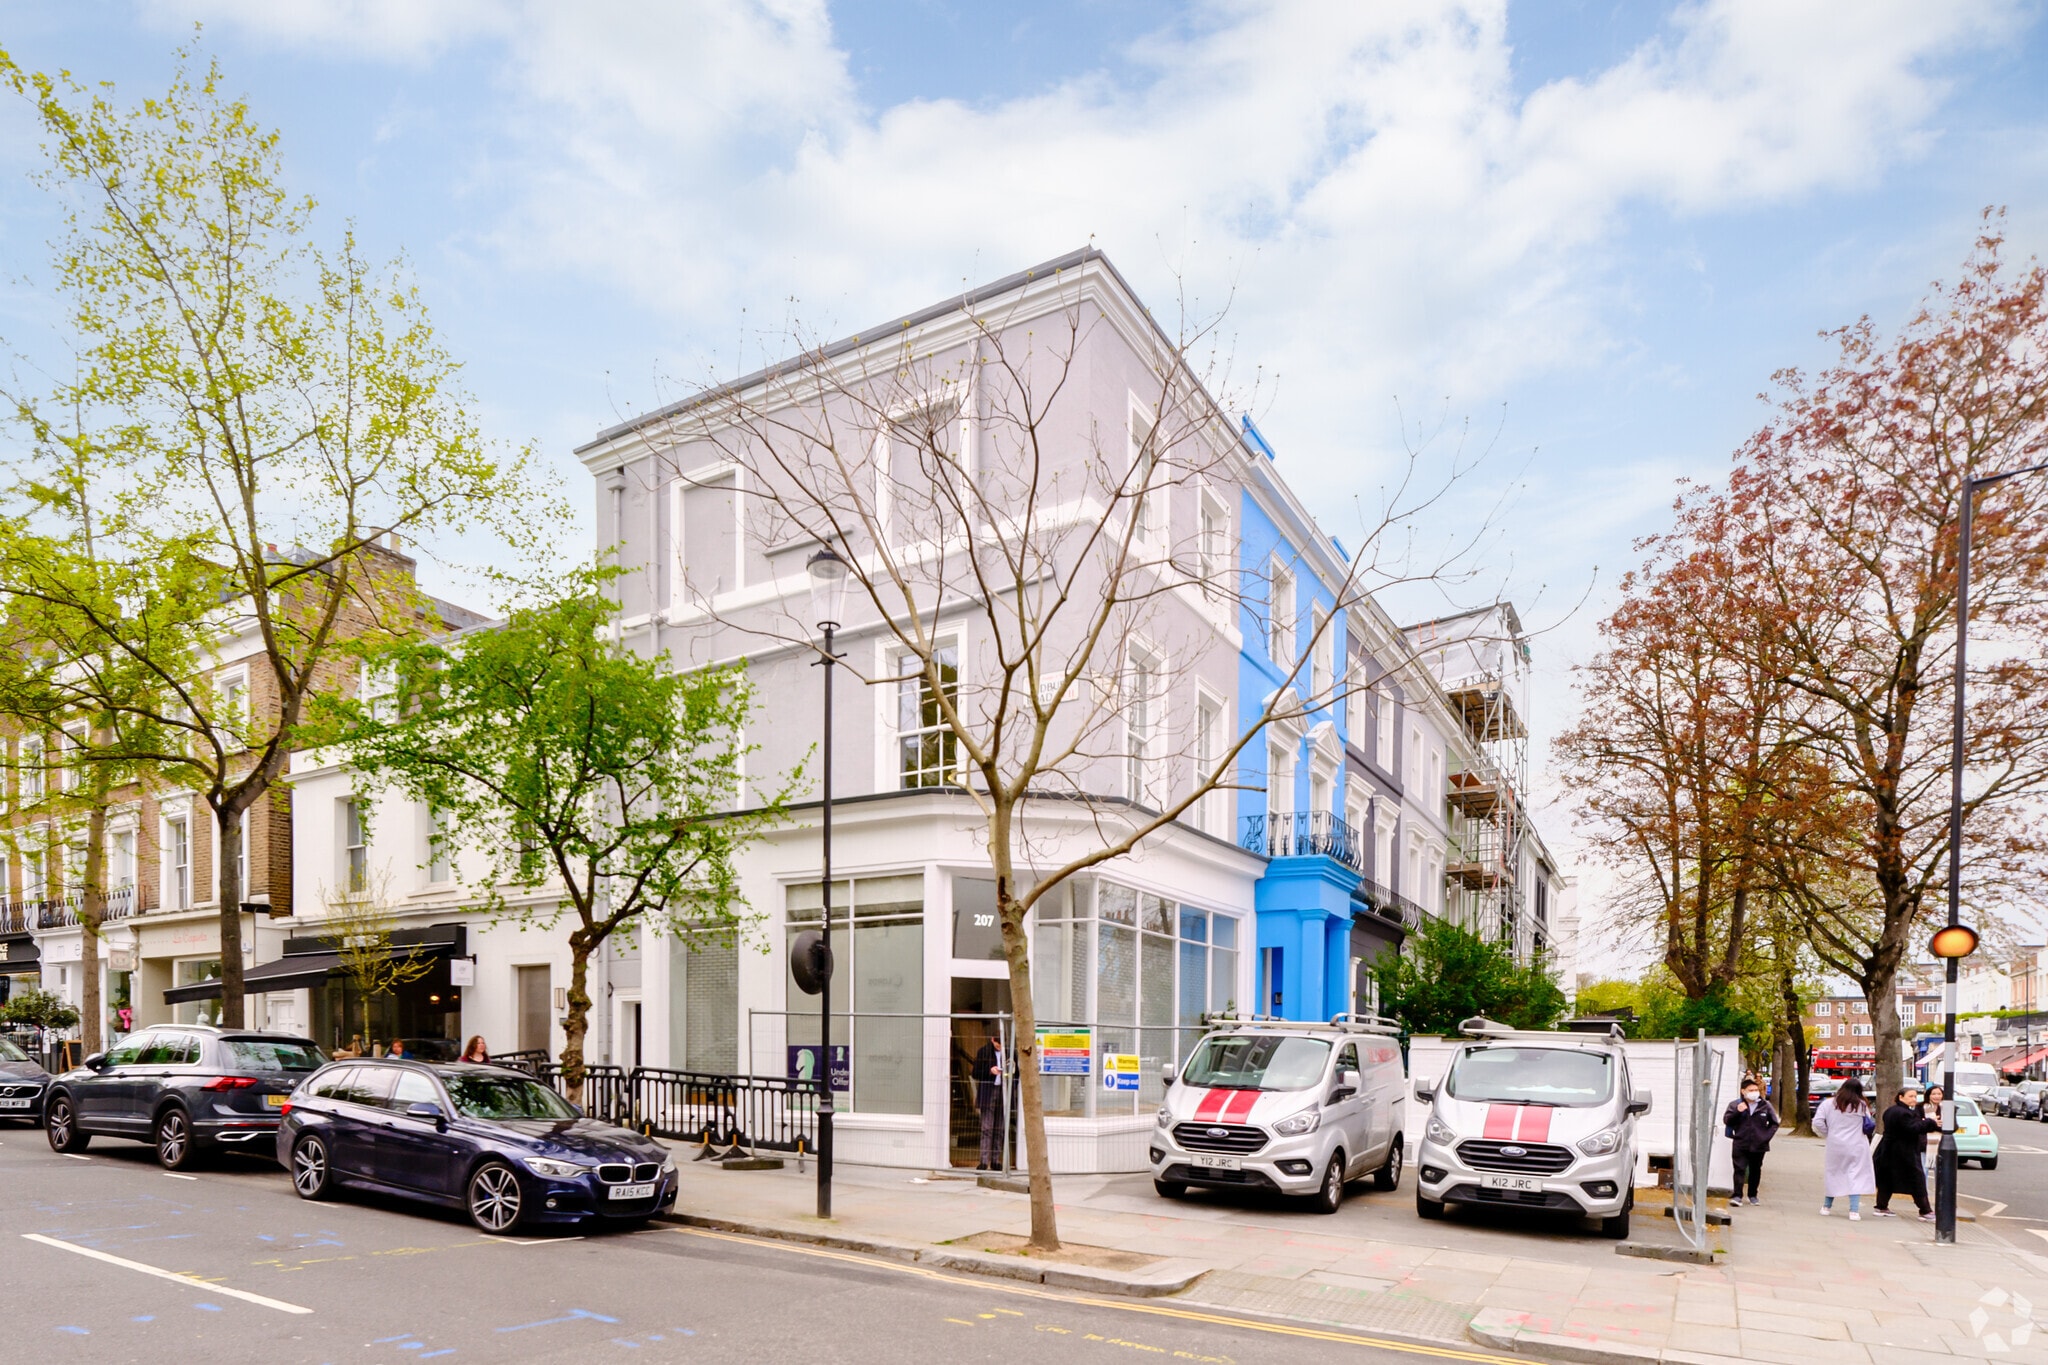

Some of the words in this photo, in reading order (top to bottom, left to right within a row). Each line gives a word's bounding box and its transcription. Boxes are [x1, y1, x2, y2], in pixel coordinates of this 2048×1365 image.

[974, 914, 994, 927] 207
[1216, 1158, 1232, 1168] JRC
[1492, 1177, 1508, 1187] K12
[1511, 1179, 1531, 1189] JRC
